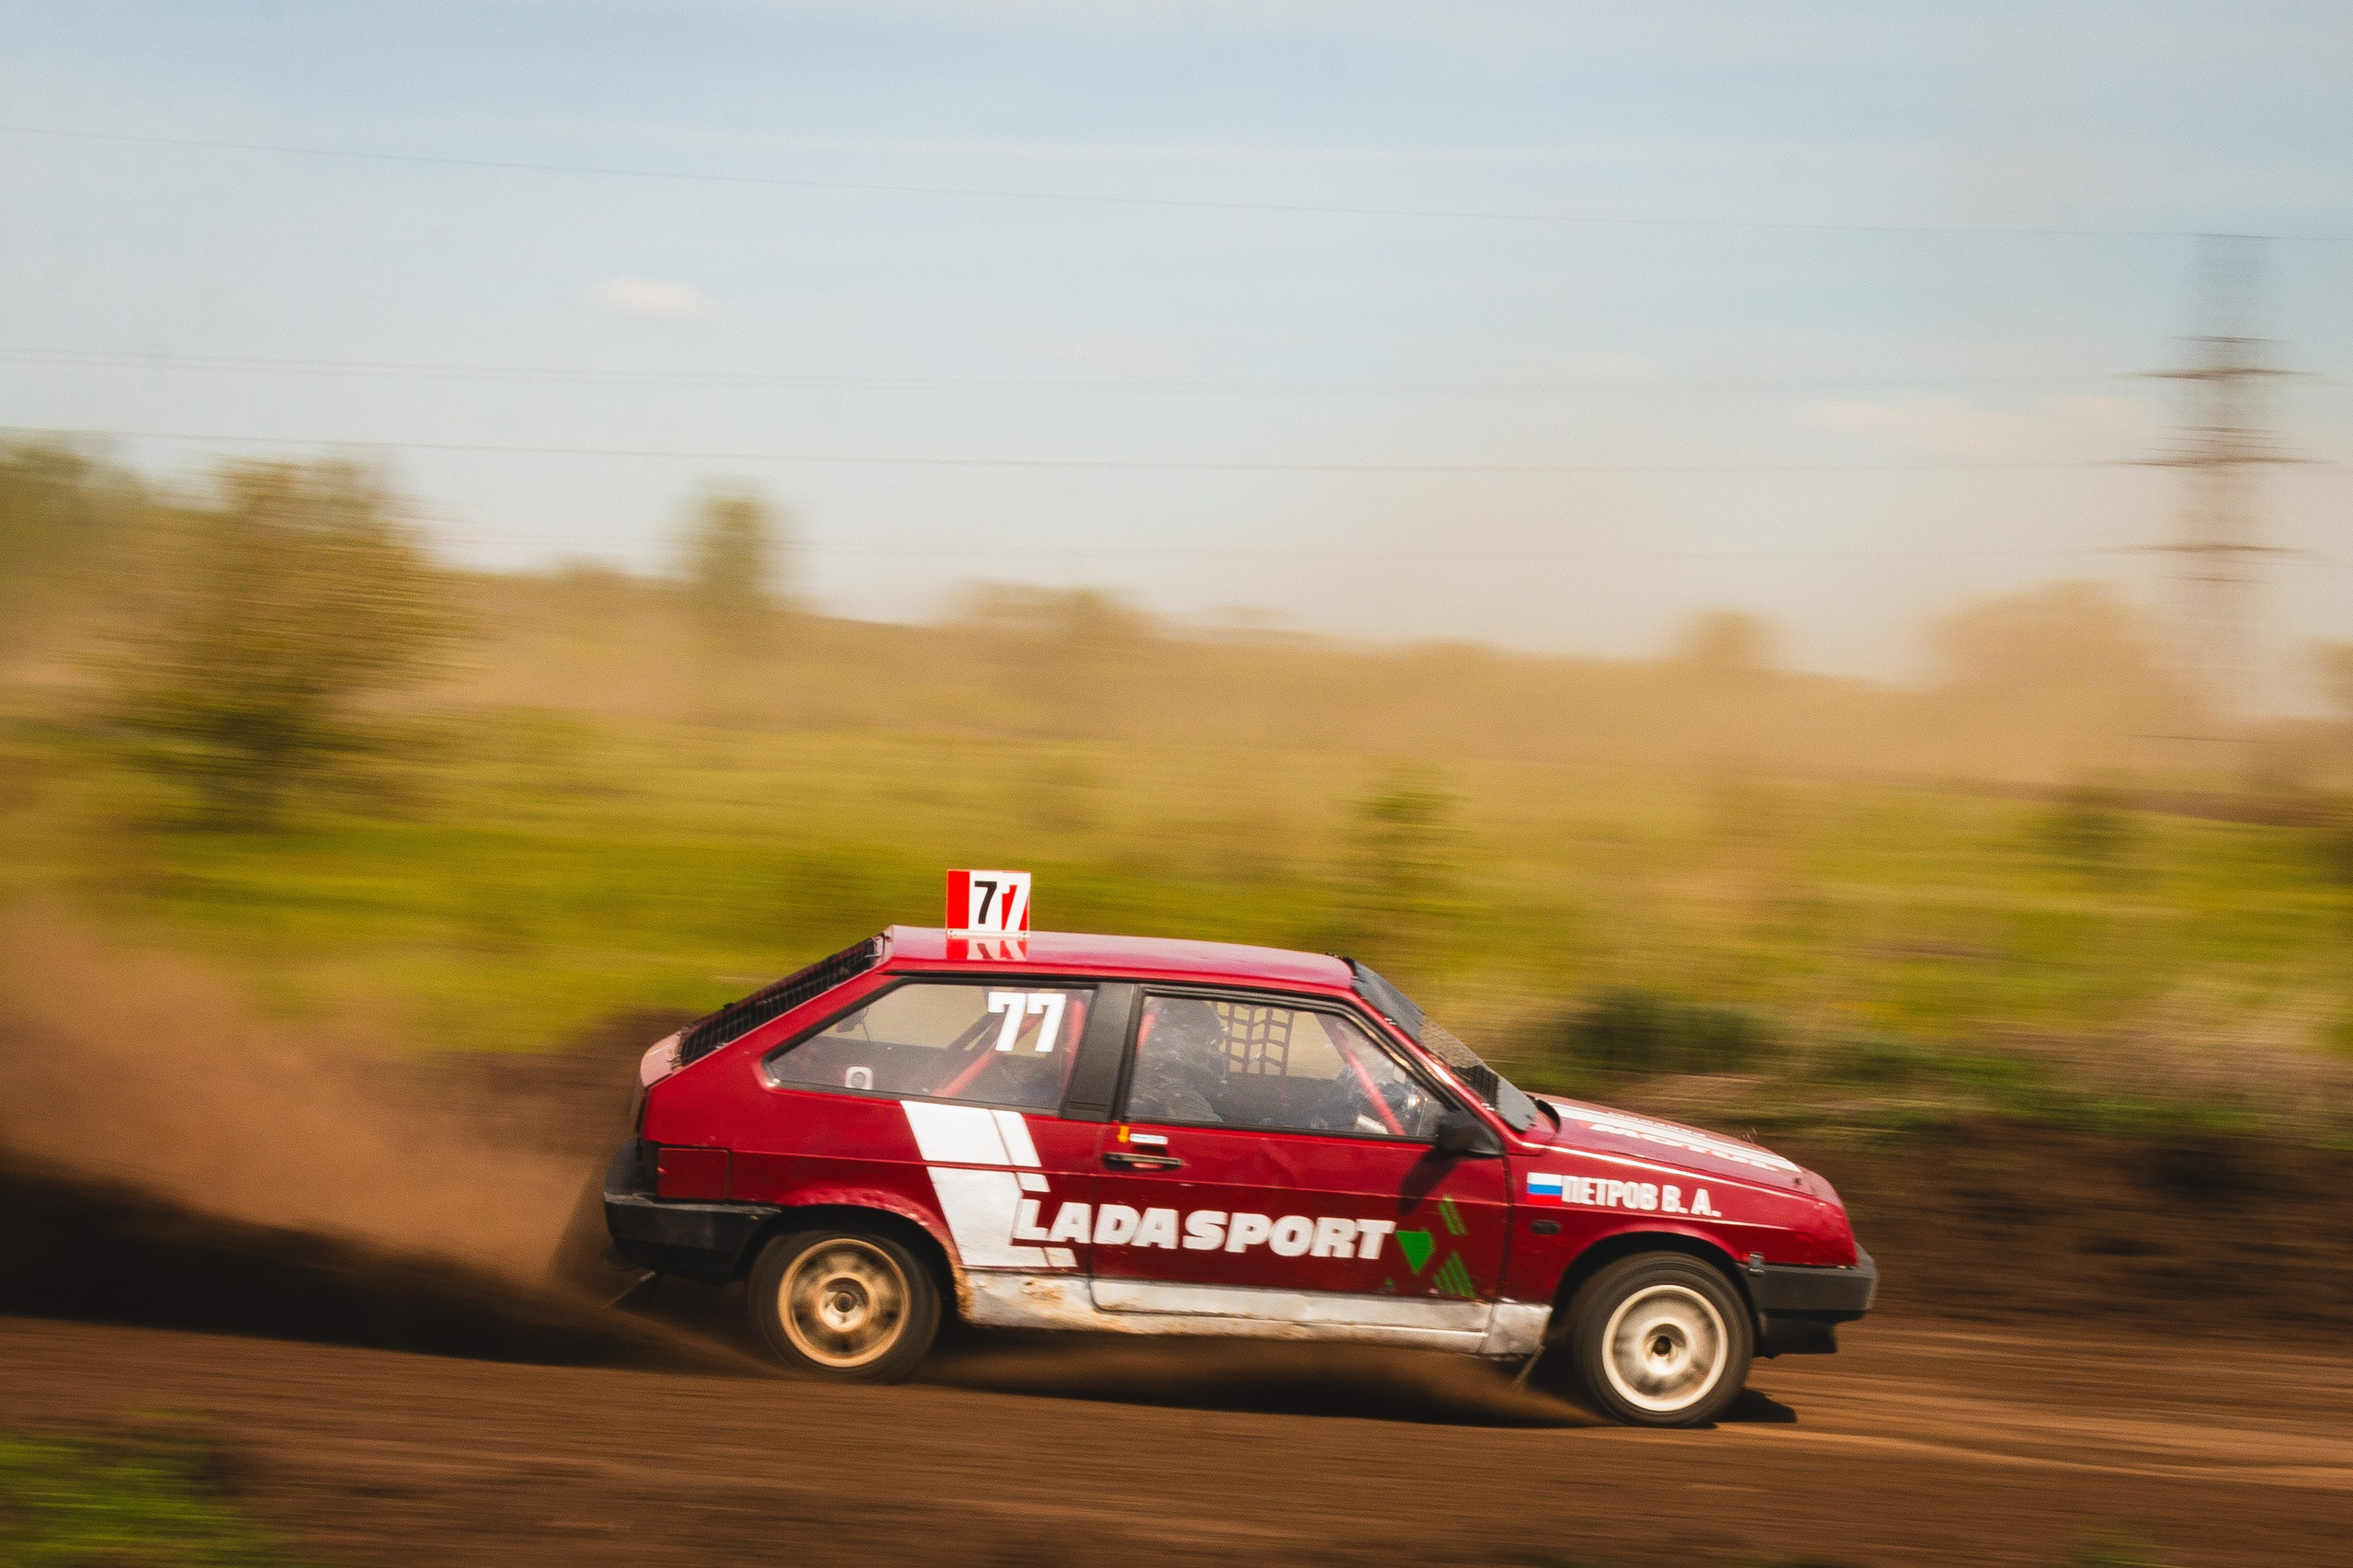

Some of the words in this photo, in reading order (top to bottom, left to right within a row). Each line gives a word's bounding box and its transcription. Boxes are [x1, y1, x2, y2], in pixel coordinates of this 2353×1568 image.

[974, 874, 1030, 931] 77
[988, 992, 1066, 1051] 77
[1562, 1176, 1659, 1211] ПЕТРОВ
[1662, 1185, 1688, 1213] В.
[1690, 1188, 1722, 1218] А.
